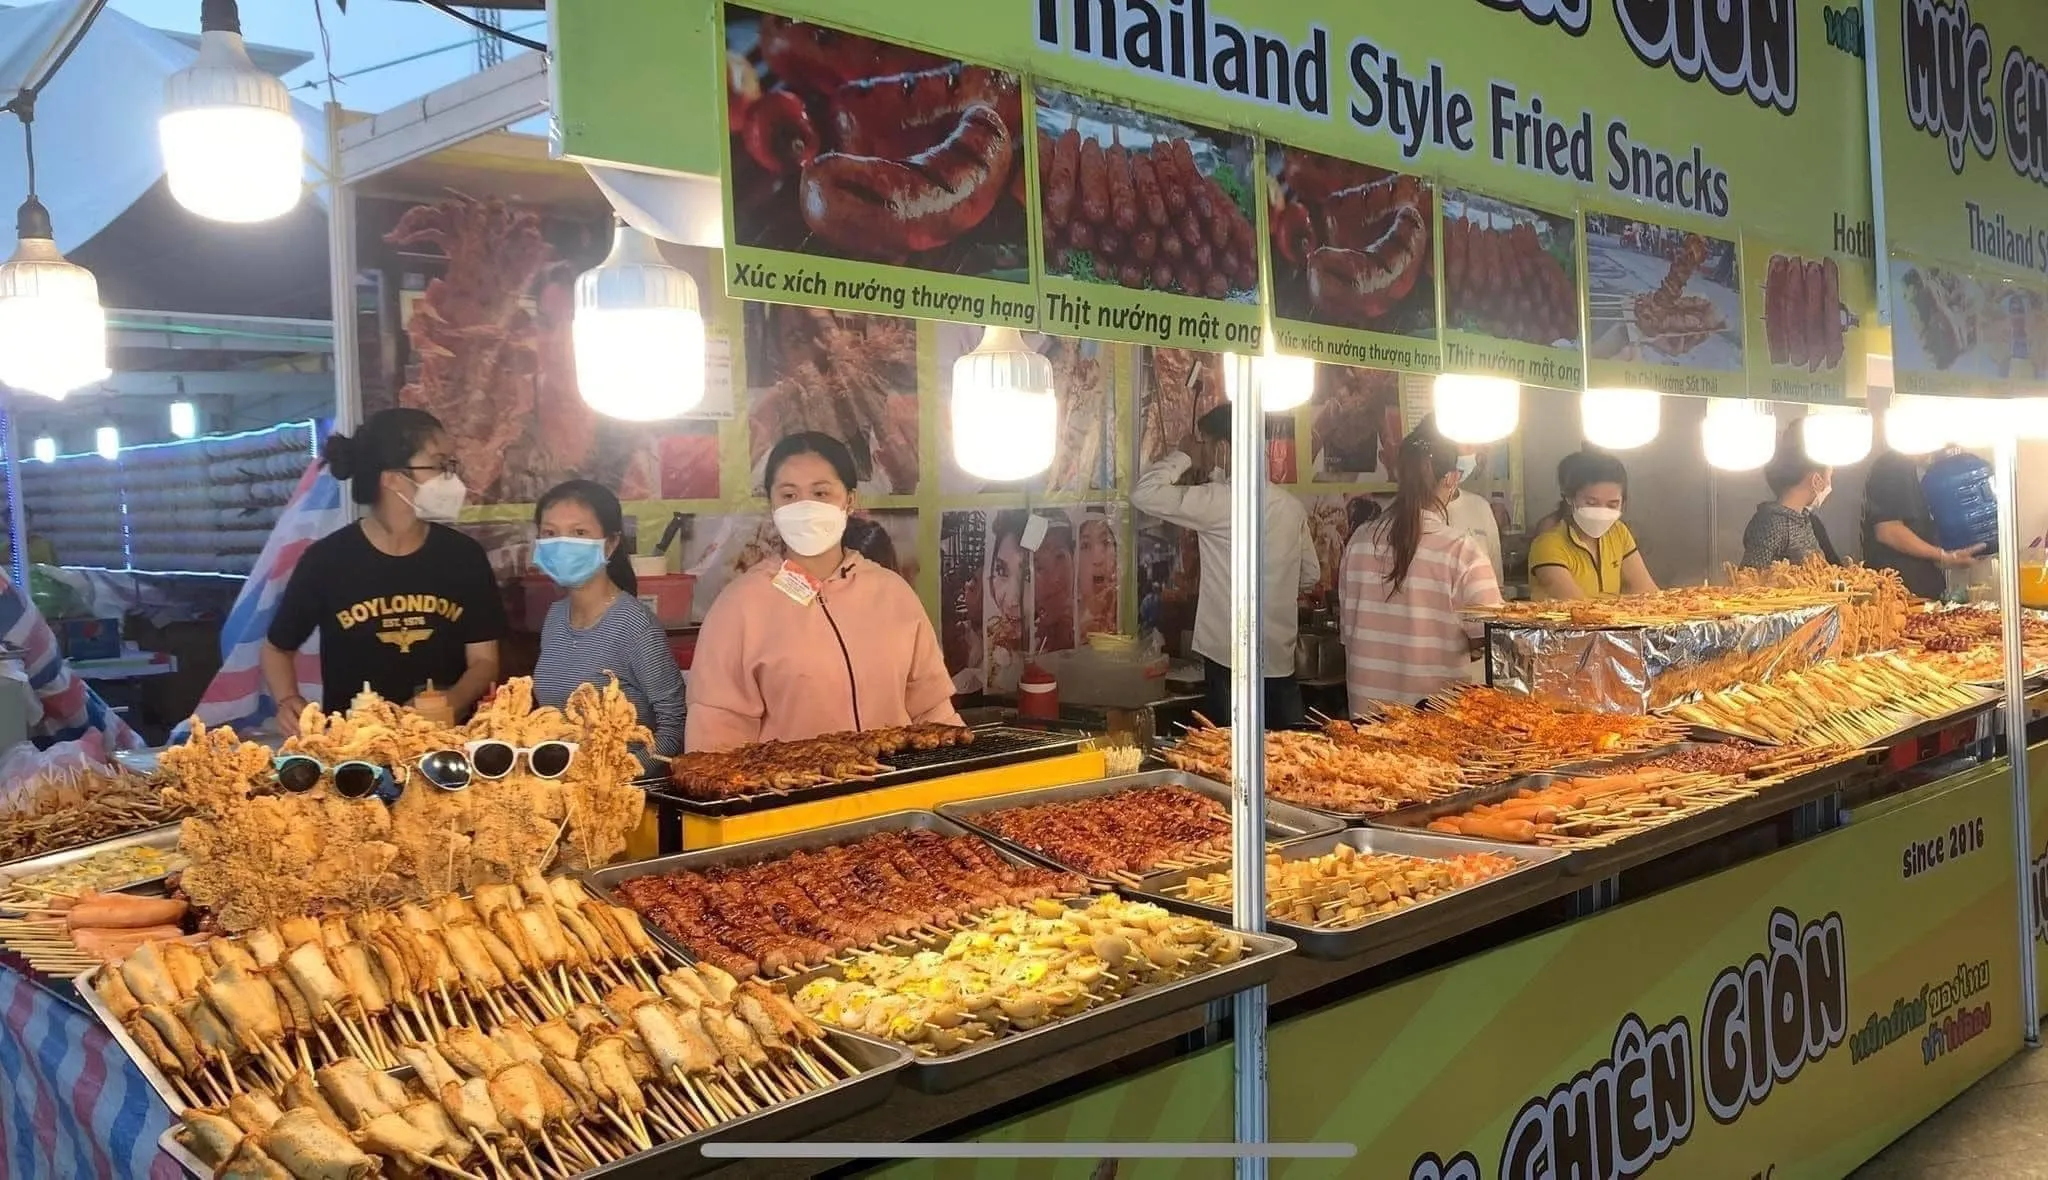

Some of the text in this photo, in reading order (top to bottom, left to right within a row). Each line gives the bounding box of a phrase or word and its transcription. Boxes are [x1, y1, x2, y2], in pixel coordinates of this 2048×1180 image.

[1036, 0, 1729, 218] Thailand Style Fried Snacks
[1965, 201, 2034, 269] Thailand
[733, 262, 1036, 324] Xúc xích nướng thượng hạng
[1046, 293, 1262, 349] Thịt nướng mật ong
[1327, 339, 1367, 361] nướng
[1369, 344, 1411, 367] thượng
[1414, 347, 1441, 370] hạng
[1446, 342, 1581, 386] Thịt nướng mật ong
[336, 594, 464, 629] BOYLONDON
[1903, 816, 1985, 878] since 2016
